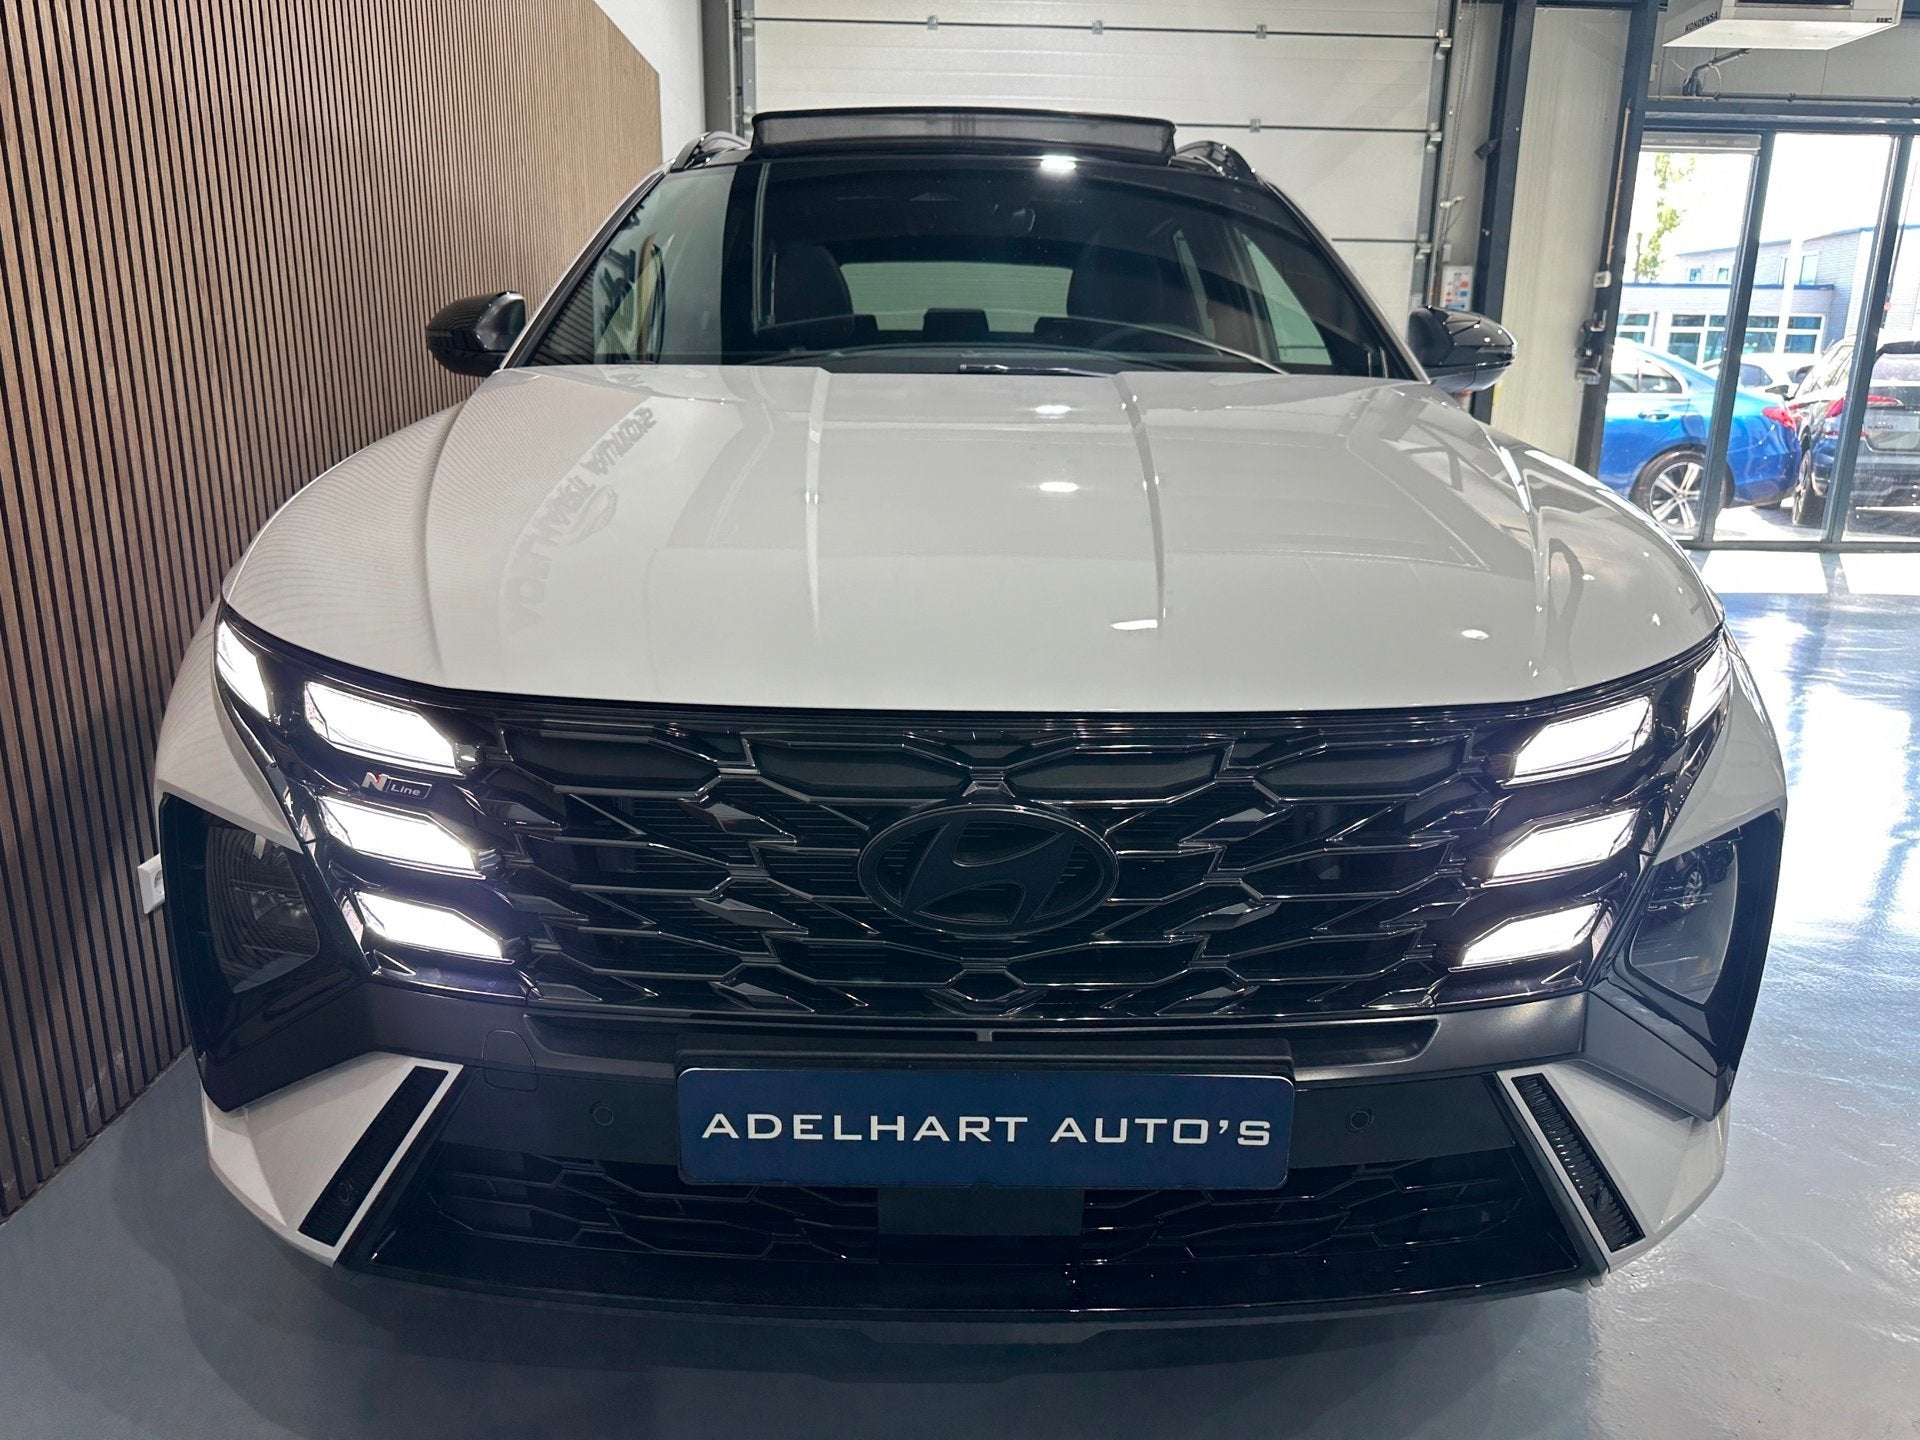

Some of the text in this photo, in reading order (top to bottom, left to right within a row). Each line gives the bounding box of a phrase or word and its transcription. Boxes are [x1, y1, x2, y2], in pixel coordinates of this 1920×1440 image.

[361, 771, 421, 796] N Line
[701, 1112, 1271, 1146] ADELHART AUTO'S
